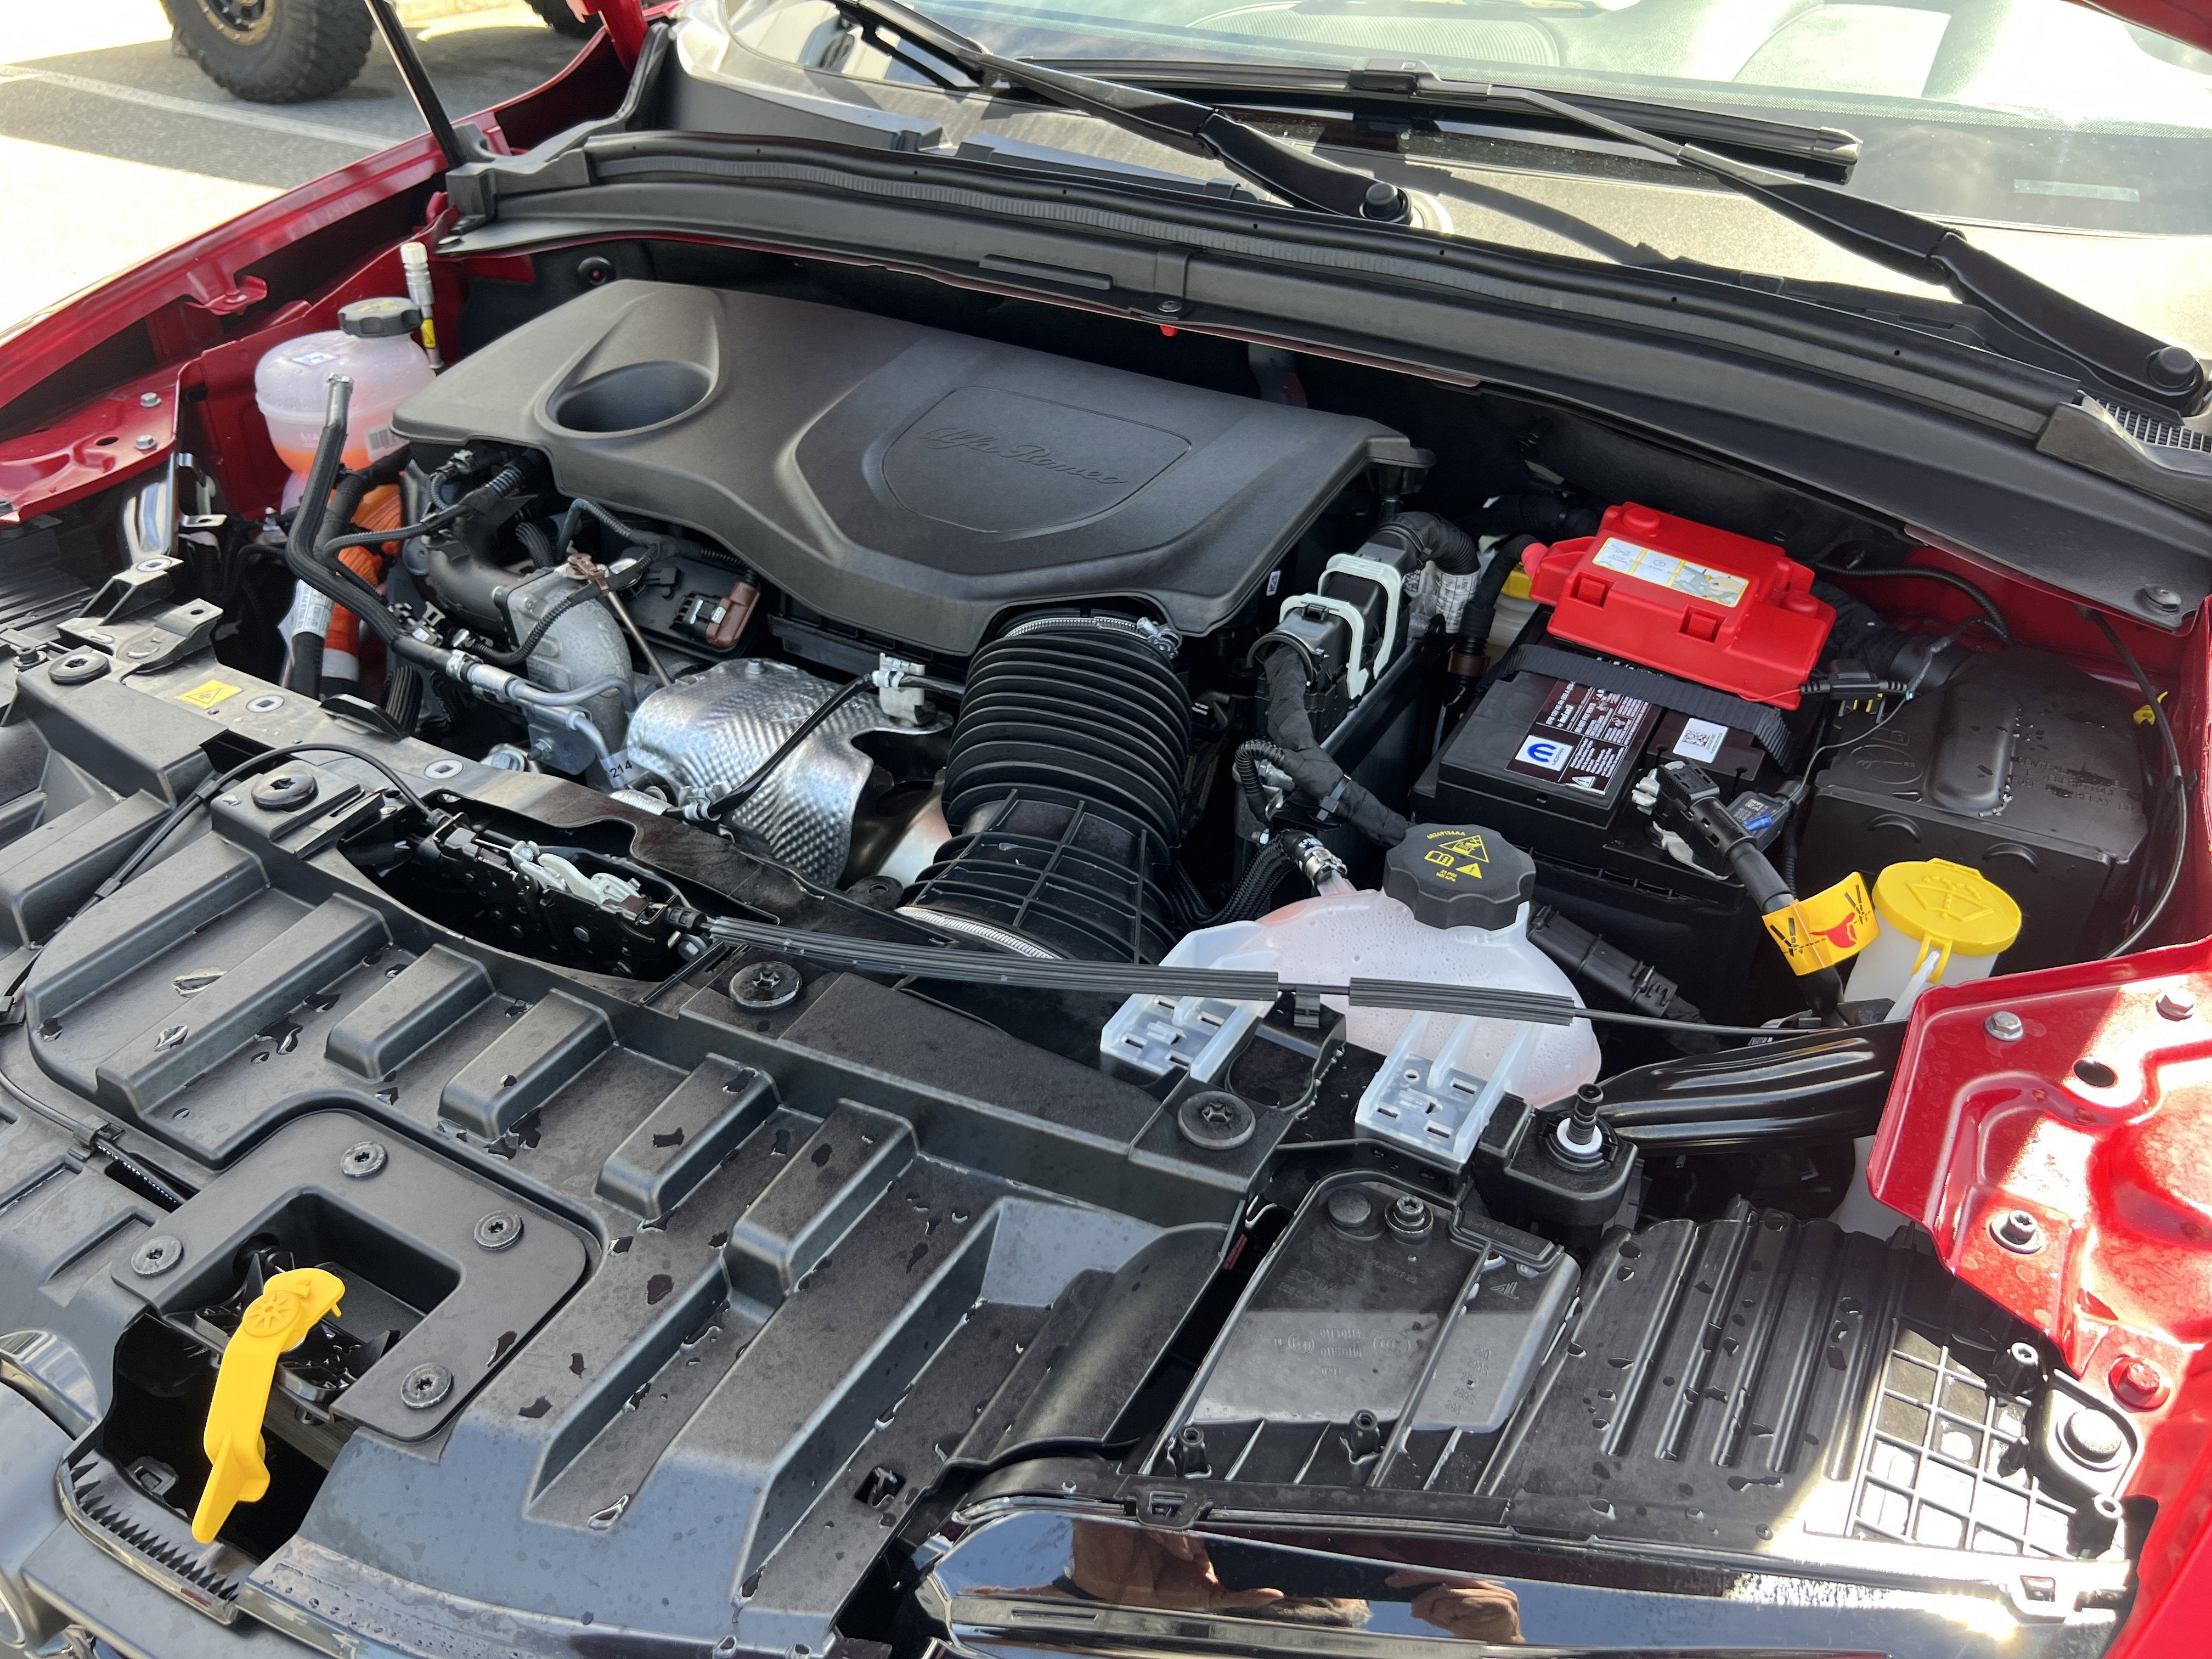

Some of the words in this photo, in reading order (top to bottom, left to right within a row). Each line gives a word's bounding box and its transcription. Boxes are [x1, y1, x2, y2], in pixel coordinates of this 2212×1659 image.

[919, 428, 1000, 454] Alfa
[998, 445, 1128, 484] Romeo
[1551, 748, 1565, 765] MOPAR
[610, 760, 633, 778] 214
